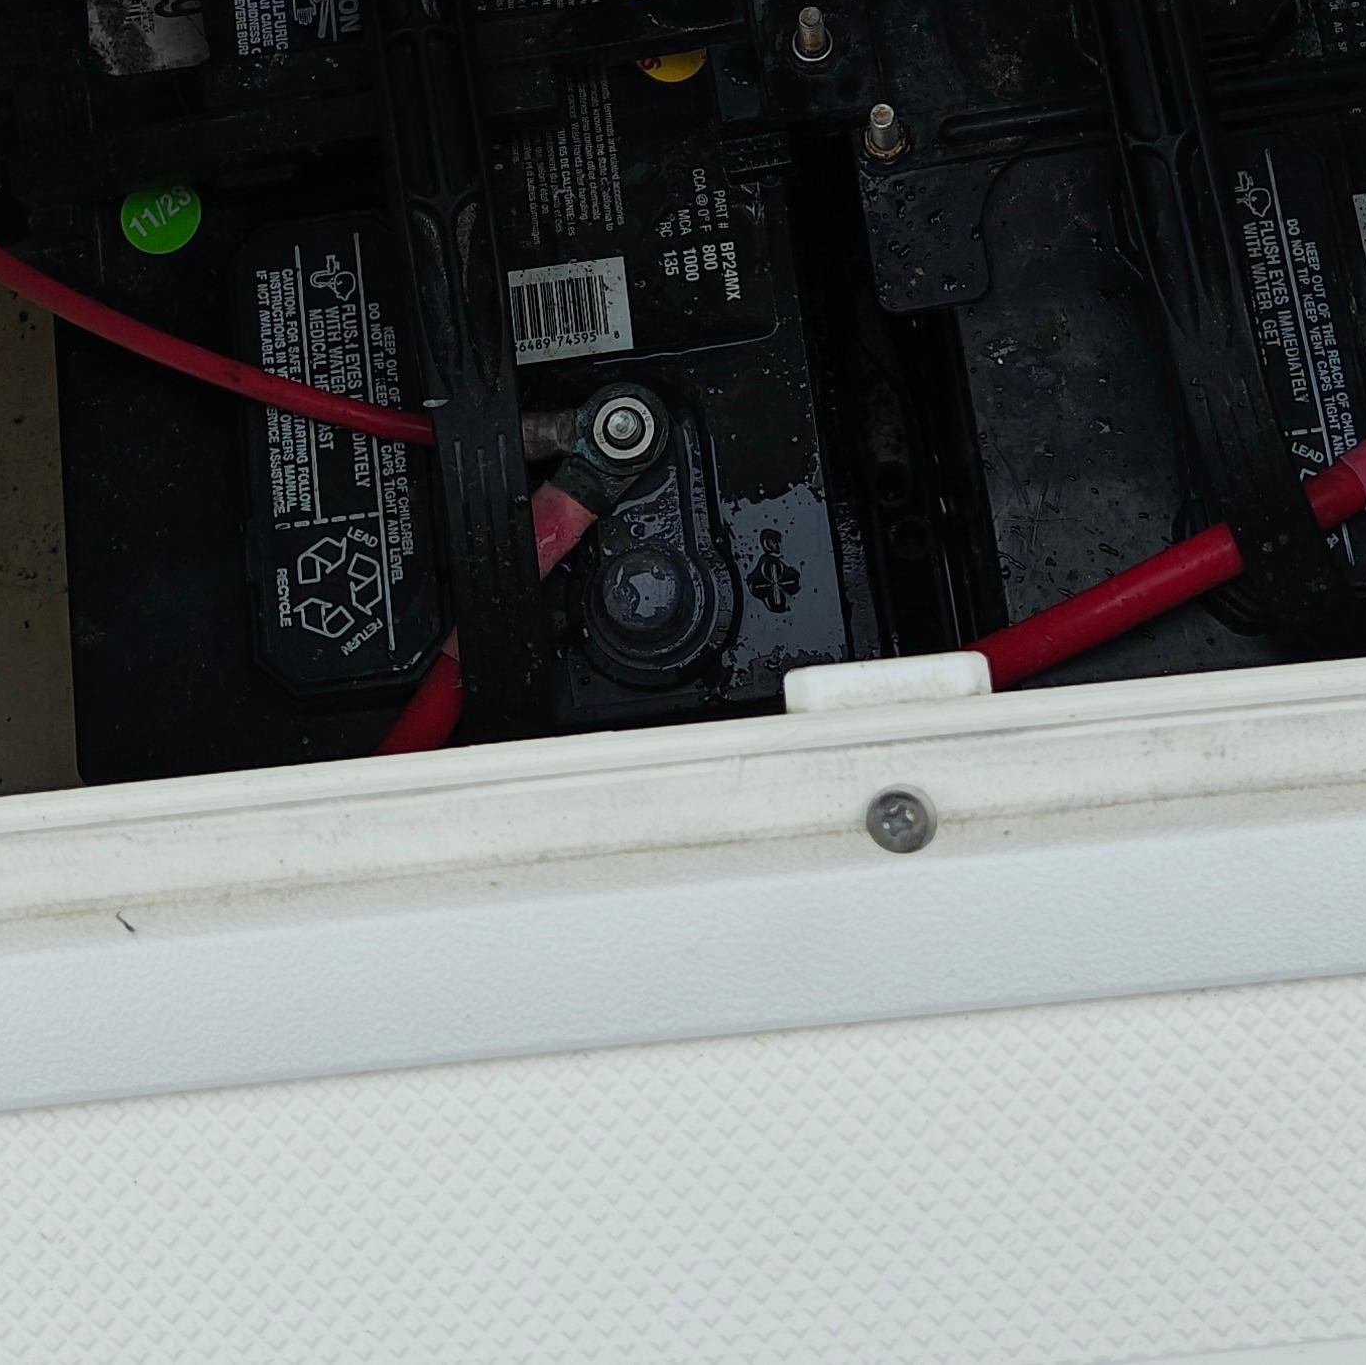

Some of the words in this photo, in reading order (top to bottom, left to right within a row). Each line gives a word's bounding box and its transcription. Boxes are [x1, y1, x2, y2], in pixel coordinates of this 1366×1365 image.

[261, 13, 273, 46] CAUSE
[559, 158, 570, 169] DE
[692, 168, 706, 192] CCA
[129, 185, 191, 237] 11/23
[696, 194, 708, 207] @
[713, 189, 729, 218] PART
[678, 209, 692, 236] MCA
[698, 209, 711, 221] 0°
[699, 225, 712, 233] F
[717, 221, 729, 229] #
[1286, 218, 1300, 235] DO
[659, 221, 673, 238] RC
[1258, 220, 1281, 264] FLUSH
[663, 250, 679, 276] 135
[683, 246, 699, 282] 1000
[702, 244, 718, 270] 800
[1291, 240, 1305, 262] NOT
[1304, 242, 1321, 270] KEEP
[256, 270, 267, 280] IF
[720, 242, 741, 302] BP24MX
[1243, 222, 1262, 258] WITH
[1262, 320, 1281, 347] GET
[258, 284, 270, 306] NOT
[1268, 269, 1289, 305] EYES
[1311, 275, 1326, 298] OUT
[270, 272, 286, 349] INSTRUCTIONS
[368, 303, 380, 320] DO
[1302, 293, 1318, 323] KEEP
[1317, 303, 1331, 318] OF
[259, 310, 275, 364] AVAILABLE
[287, 321, 298, 342] FOR
[325, 306, 342, 341] WITH
[370, 324, 383, 346] NOT
[1320, 322, 1337, 346] THE
[382, 325, 396, 355] KEEP
[515, 338, 550, 352] 6489
[558, 332, 596, 346] 74595
[1308, 327, 1325, 356] VENT
[276, 353, 286, 364] IN
[288, 347, 301, 373] SAFE
[1277, 310, 1309, 403] IMMEDIATELY
[1327, 349, 1345, 388] REACH
[308, 309, 328, 369] MEDICAL
[318, 424, 334, 450] AST
[345, 353, 363, 389] EYES
[386, 360, 398, 382] OUT
[1317, 361, 1332, 391] CAPS
[389, 388, 400, 403] OF
[1336, 392, 1350, 408] OF
[266, 408, 279, 443] ERVICE
[1323, 395, 1342, 430] TIGHT
[280, 415, 292, 461] OWNERS
[381, 445, 393, 475] CAPS
[393, 443, 405, 473] EACH
[1291, 442, 1325, 463] LEAD
[298, 467, 311, 511] FOLLOW
[384, 481, 398, 515] TIGHT
[396, 478, 407, 492] OF
[346, 525, 379, 548] LEAD
[387, 520, 400, 544] AND
[398, 496, 414, 555] CHILDREN
[390, 549, 403, 584] LEVEL
[277, 567, 292, 628] RECYCLE
[341, 617, 383, 657] RETURN
